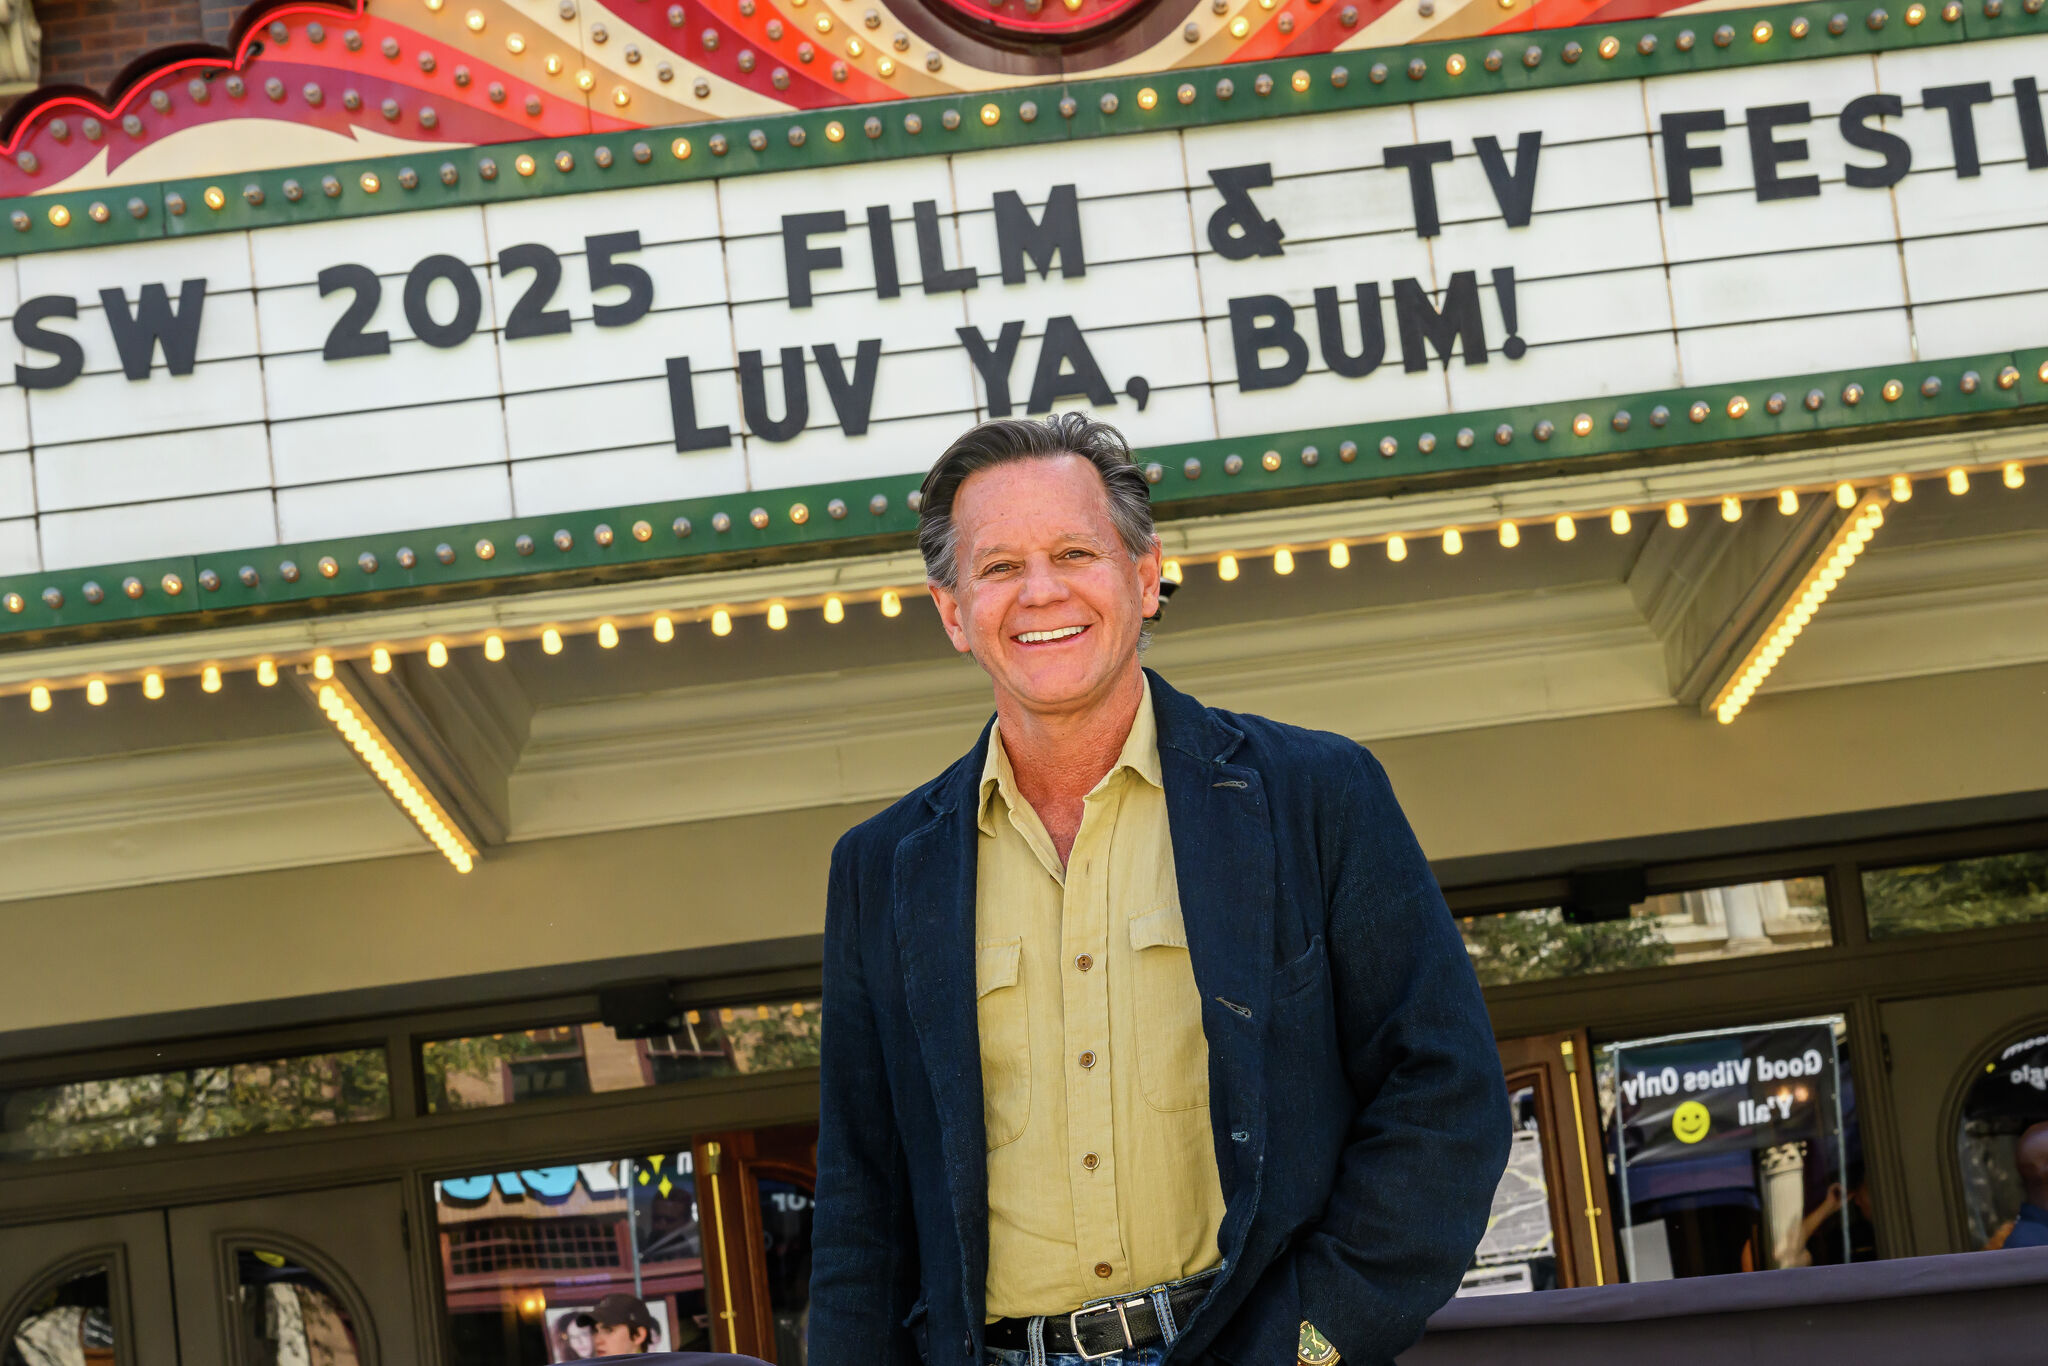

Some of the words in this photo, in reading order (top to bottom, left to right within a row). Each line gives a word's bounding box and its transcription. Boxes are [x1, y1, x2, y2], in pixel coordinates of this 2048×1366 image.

[12, 277, 207, 389] SW
[318, 230, 654, 360] 2025
[782, 183, 1086, 309] FILM
[1208, 162, 1285, 261] &
[1383, 130, 1543, 238] TV
[1661, 76, 2048, 208] FESTI
[666, 338, 882, 453] LUV
[956, 314, 1150, 418] YA,
[1228, 266, 1527, 393] BUM!
